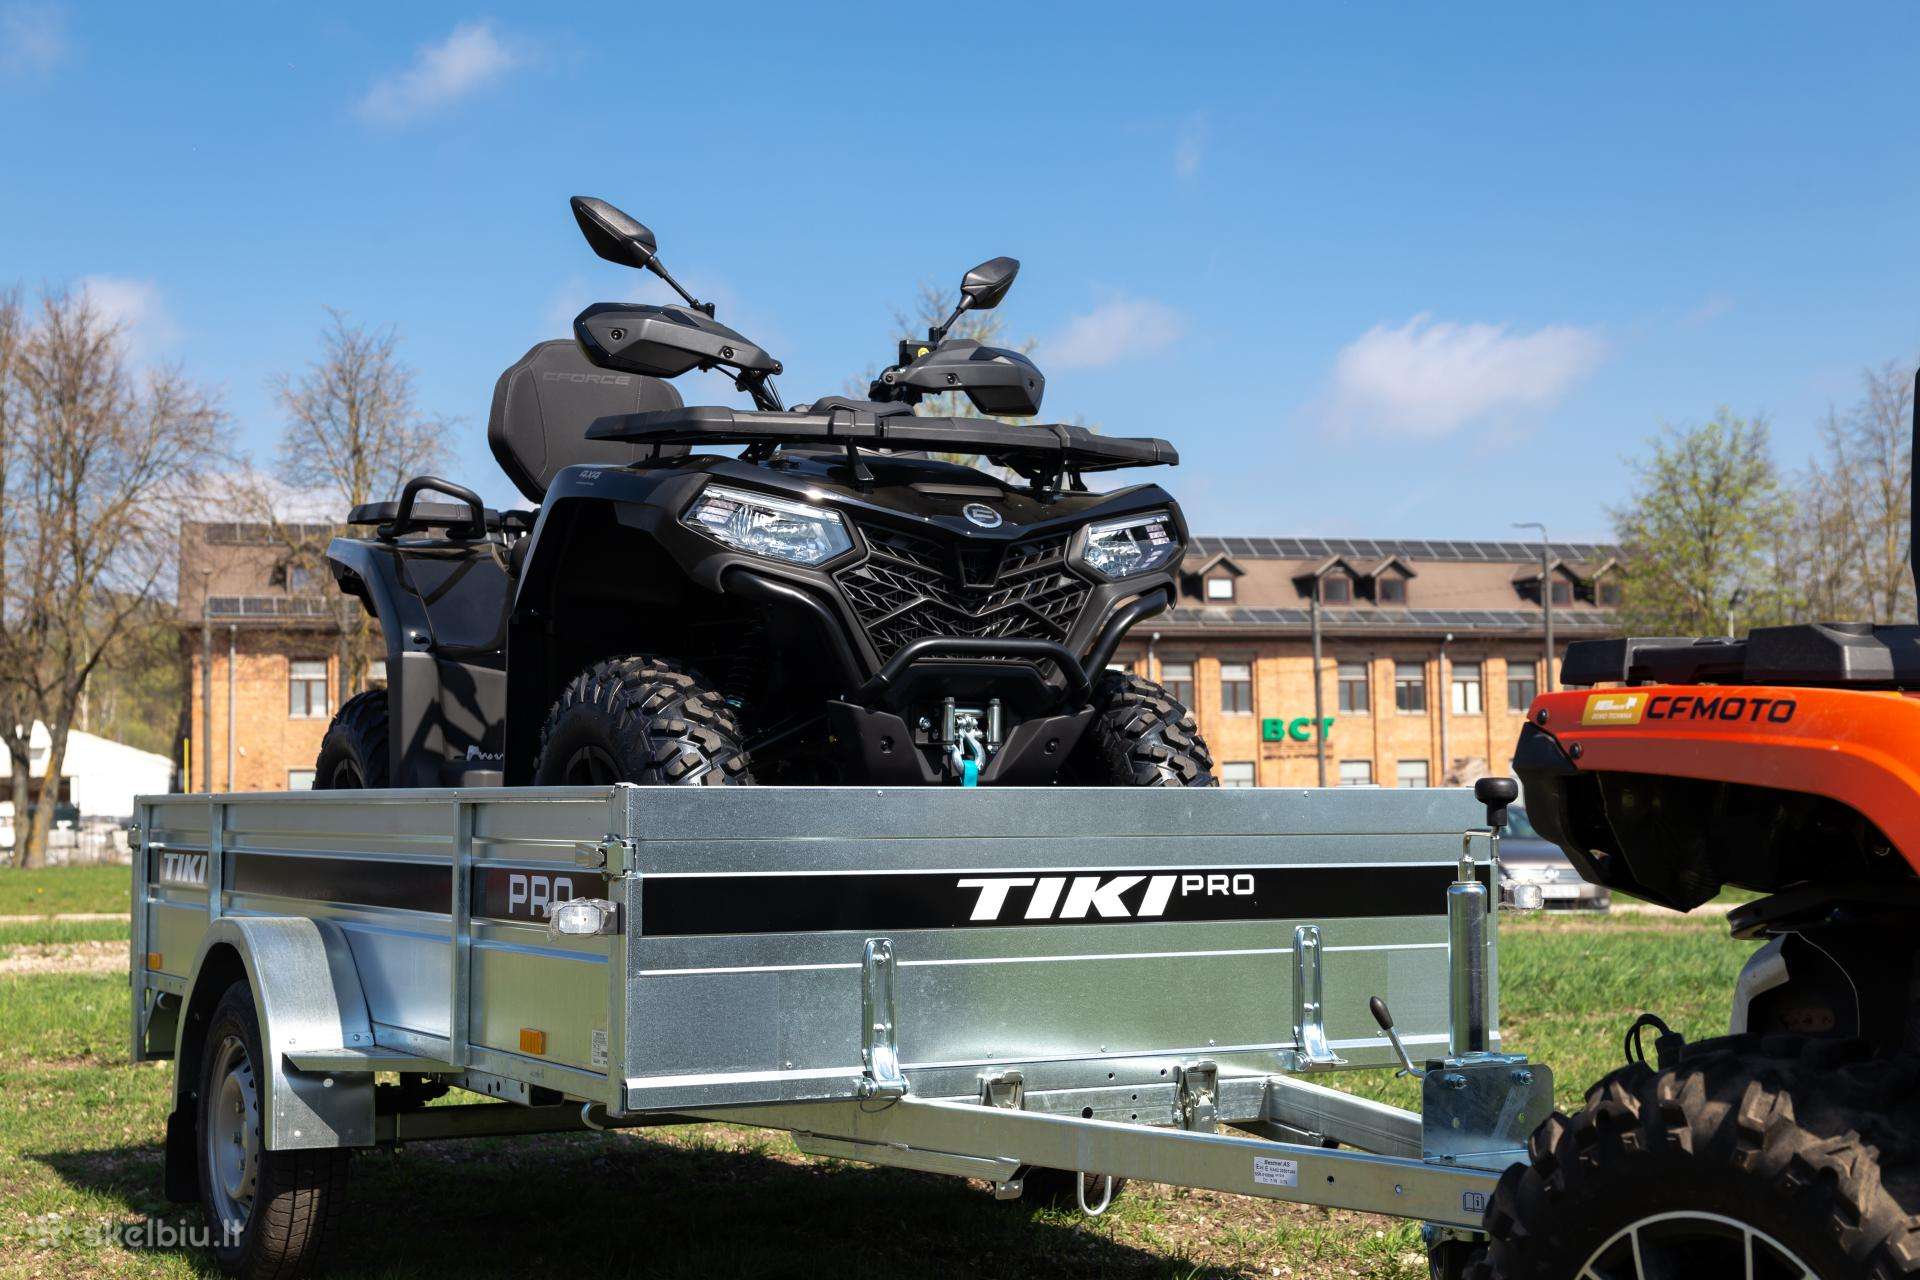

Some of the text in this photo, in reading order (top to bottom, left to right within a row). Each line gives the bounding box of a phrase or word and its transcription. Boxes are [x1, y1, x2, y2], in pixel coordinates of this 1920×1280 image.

[1646, 696, 1797, 724] CFMOTO
[1262, 716, 1335, 742] BCT
[163, 852, 208, 884] TIKI
[956, 874, 1255, 921] TIKI PRO
